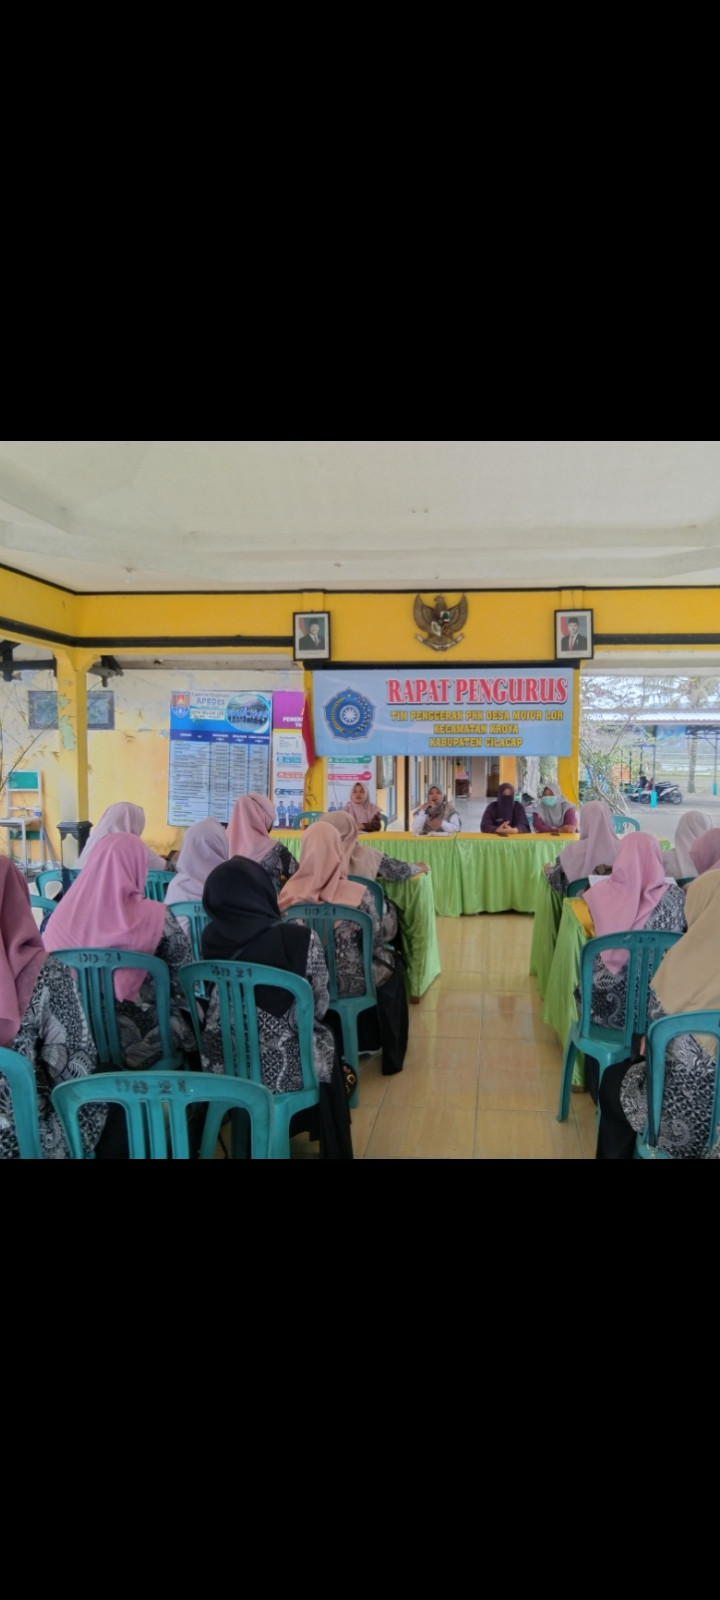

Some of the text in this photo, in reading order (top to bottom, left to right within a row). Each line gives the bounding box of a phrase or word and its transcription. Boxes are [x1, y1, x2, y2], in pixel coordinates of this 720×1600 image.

[387, 677, 568, 704] RAPAT PENGURUS
[391, 710, 564, 721] TIM PENGGERAK PKK DESA MUJUR LOR
[433, 724, 519, 735] KECAMATAN KROYA
[429, 737, 523, 748] KABUPATEN CILACAP
